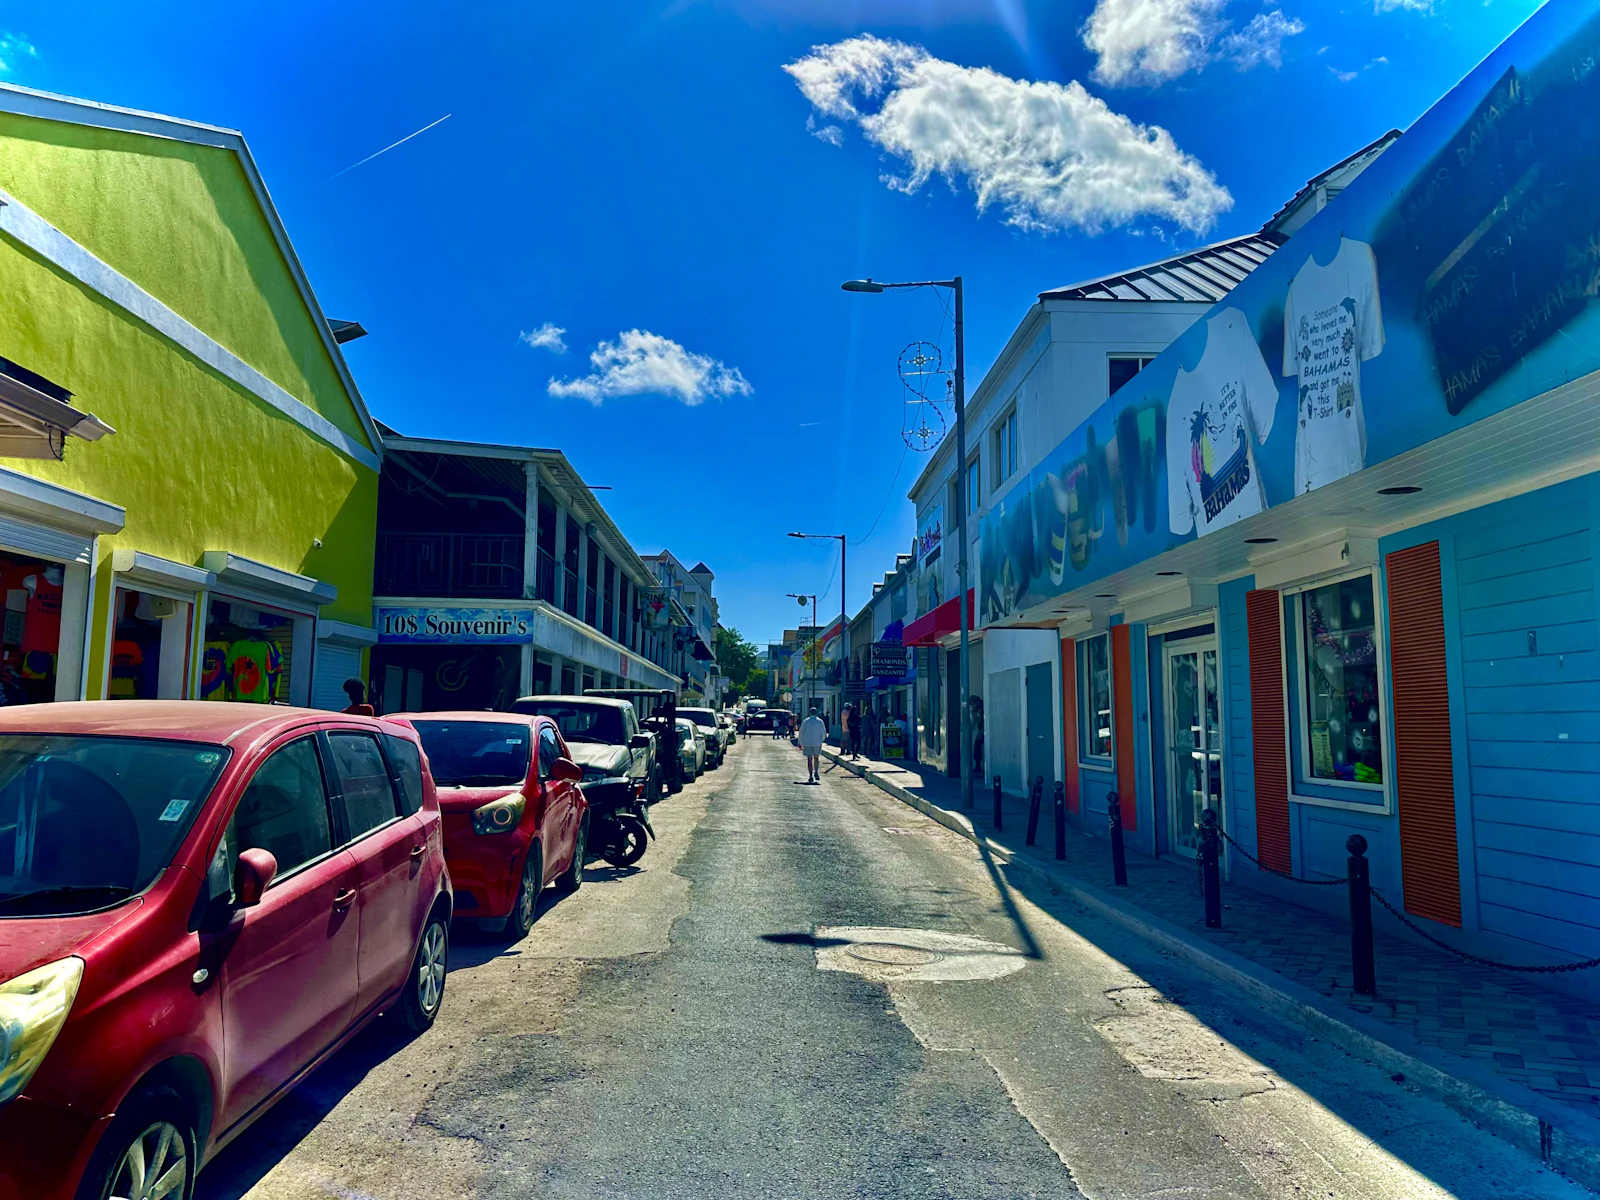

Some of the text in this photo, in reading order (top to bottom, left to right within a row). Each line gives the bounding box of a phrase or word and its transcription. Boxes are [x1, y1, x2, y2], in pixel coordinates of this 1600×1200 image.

[1313, 304, 1339, 321] Someone
[1309, 323, 1320, 335] who
[1338, 315, 1348, 325] me
[1311, 328, 1341, 348] very much
[1313, 344, 1340, 361] went to
[1303, 356, 1351, 378] BAHAMAS
[1220, 382, 1231, 396] IT'S
[1309, 376, 1340, 393] and got me
[1218, 388, 1238, 412] BETTER
[1317, 393, 1331, 405] this
[1221, 399, 1239, 421] IN THE
[1312, 406, 1335, 419] T-Shirt
[384, 613, 528, 636] 10$ Souvenir's
[872, 658, 907, 666] DIAMONDS
